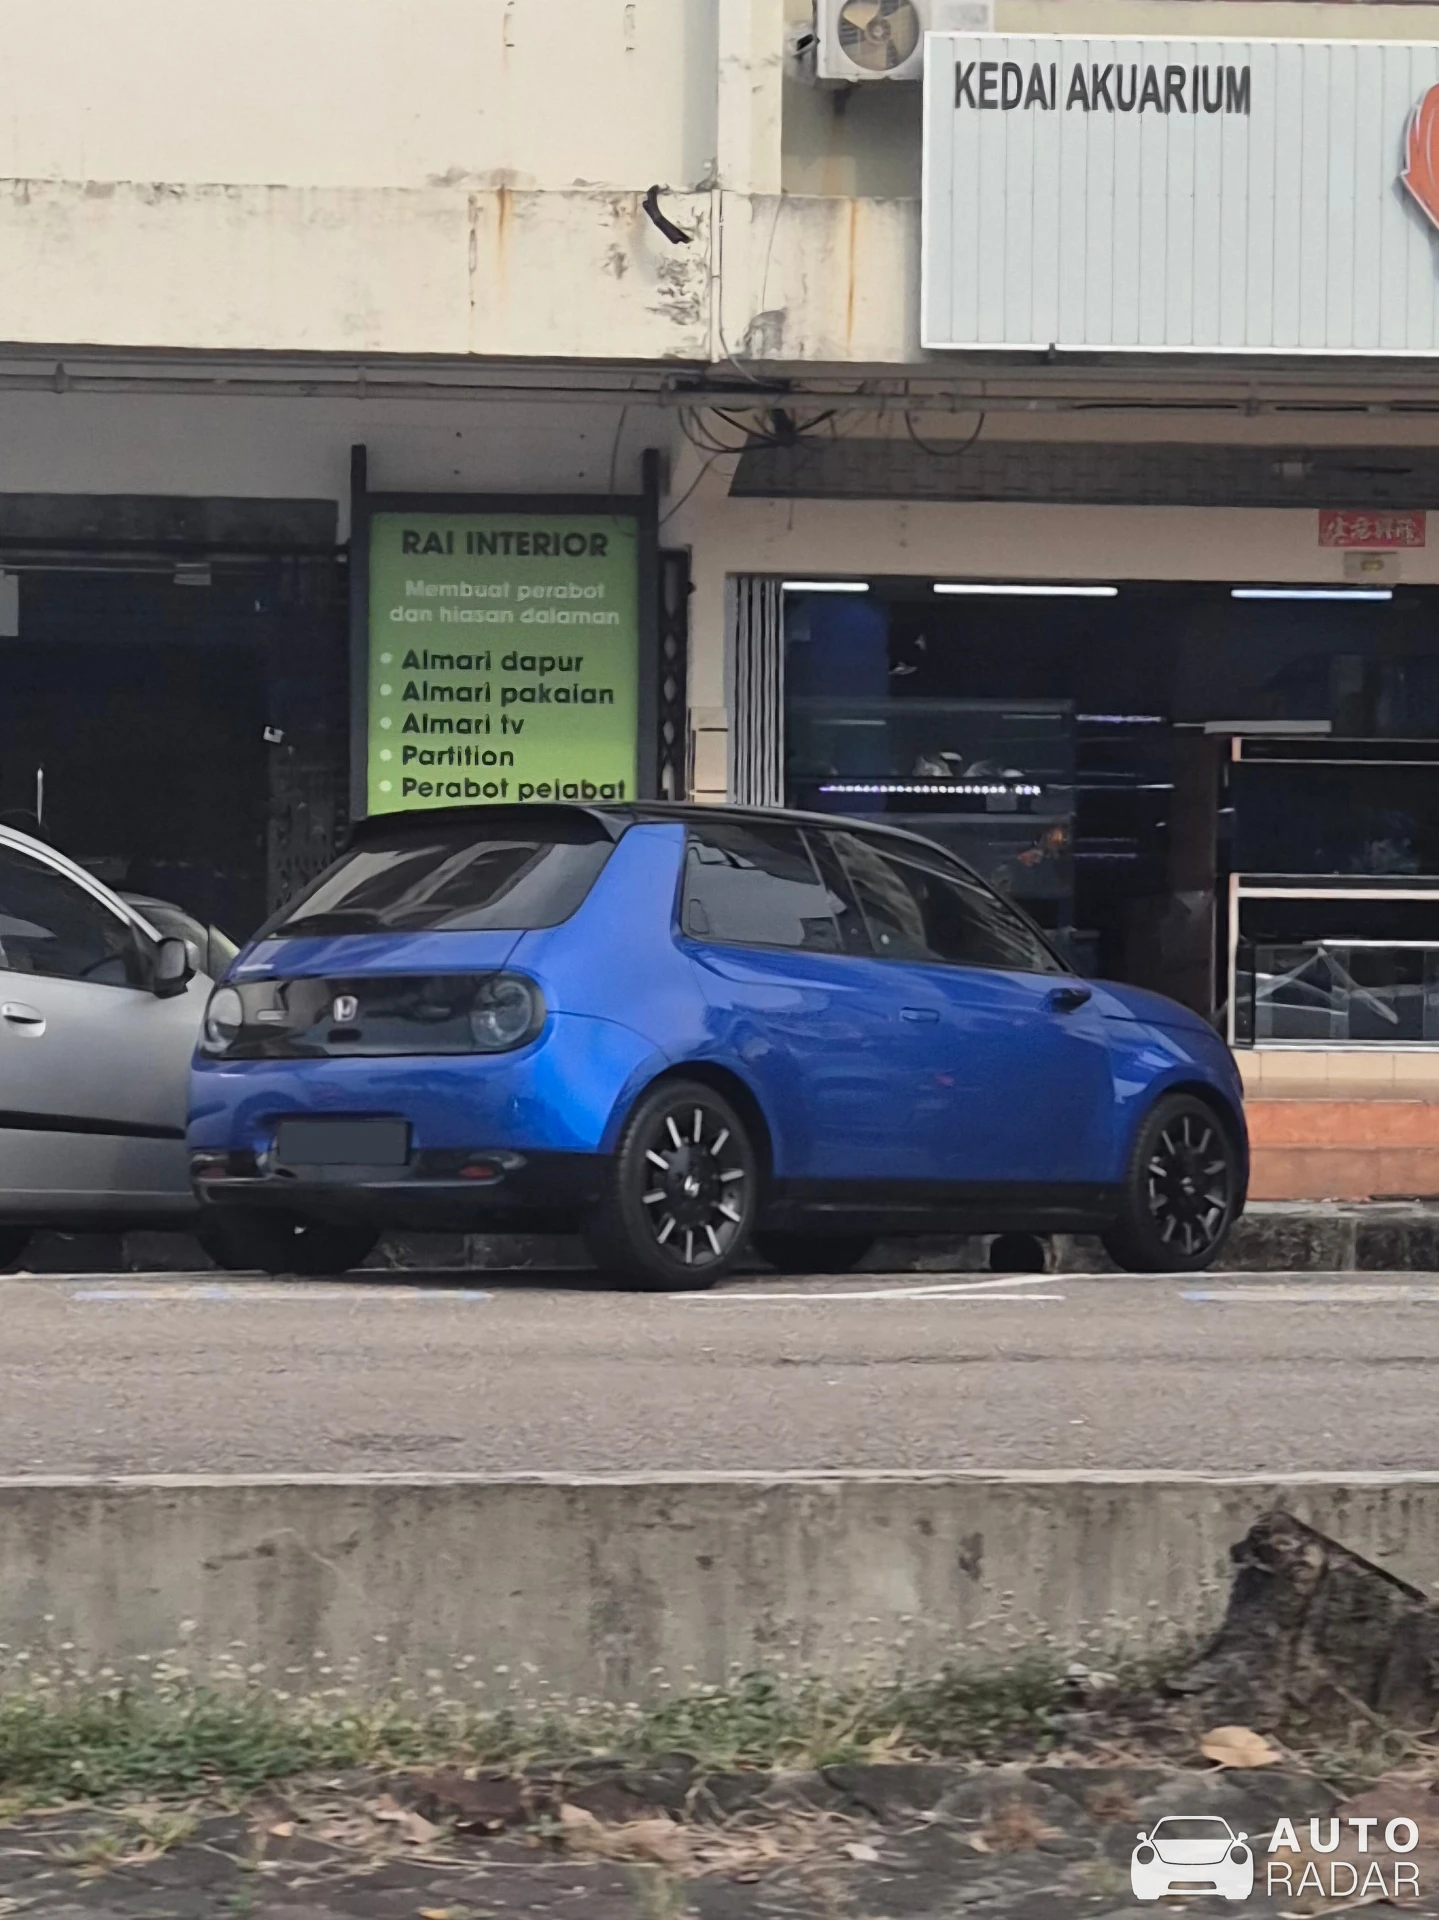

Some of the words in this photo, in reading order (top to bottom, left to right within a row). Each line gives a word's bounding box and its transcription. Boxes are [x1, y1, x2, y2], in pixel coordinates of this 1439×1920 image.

[954, 60, 1057, 111] KEDAI
[1065, 63, 1251, 115] AKUARIUM
[401, 529, 454, 555] RAI
[467, 532, 608, 557] INTERIOR
[405, 580, 510, 598] Membuat
[517, 582, 605, 601] perabot
[389, 606, 433, 622] dan
[440, 606, 514, 623] hiasan
[519, 607, 620, 625] dalaman
[401, 649, 492, 671] Almari
[500, 651, 584, 676] dapur
[401, 681, 491, 703] Almari
[501, 683, 614, 707] pakaian
[401, 713, 491, 735] Almari
[501, 714, 525, 735] tv
[402, 745, 514, 767] Partition
[402, 777, 509, 799] Perabot
[518, 779, 626, 801] pejabat
